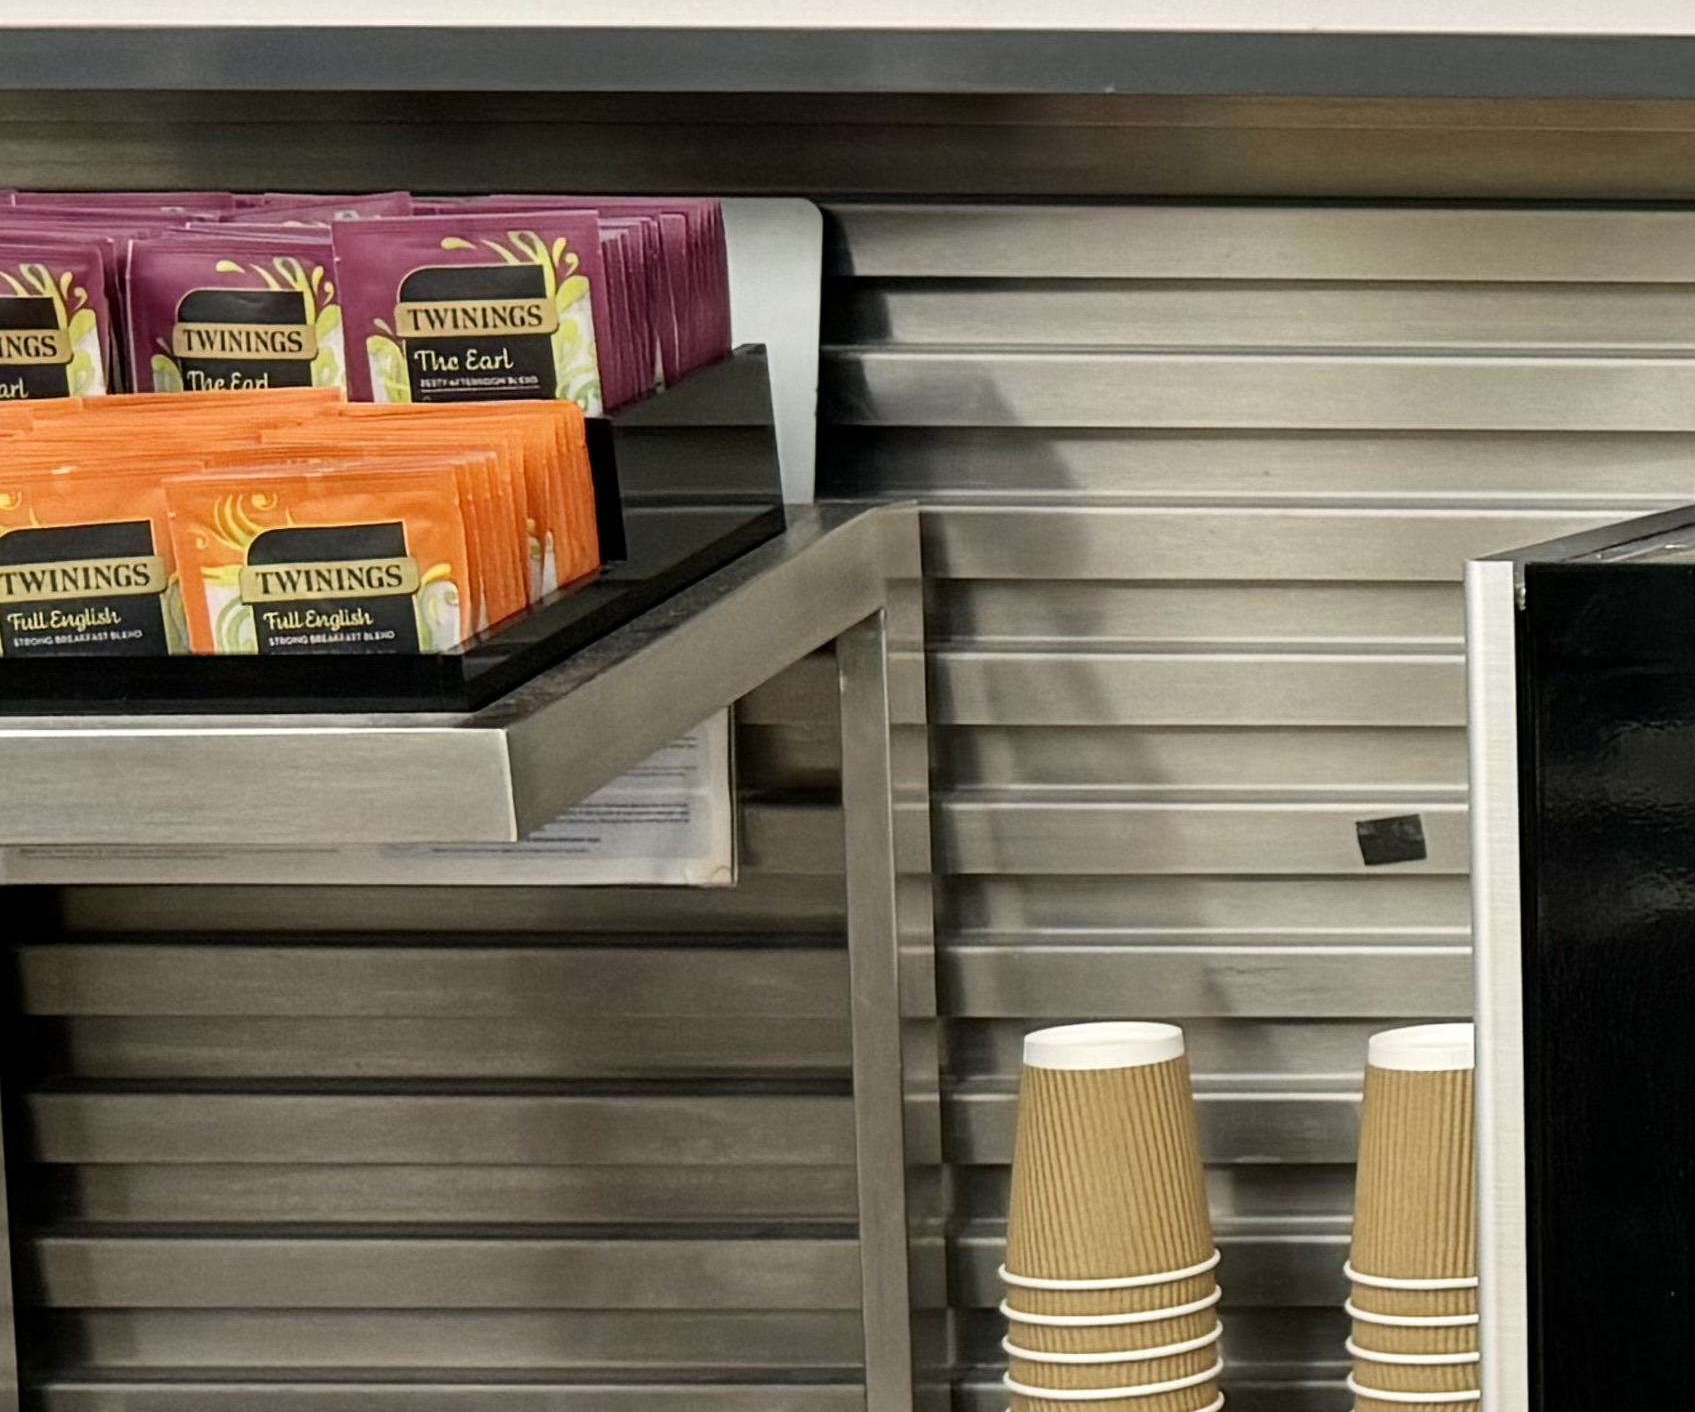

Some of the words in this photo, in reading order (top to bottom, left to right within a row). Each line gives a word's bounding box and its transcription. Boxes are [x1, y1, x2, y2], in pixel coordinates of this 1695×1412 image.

[407, 305, 543, 330] TWININGS
[183, 329, 304, 353] TWININGS
[414, 350, 459, 371] The
[466, 347, 514, 370] Earl
[0, 377, 29, 398] arl
[187, 371, 226, 391] The
[230, 372, 269, 390] Earl
[0, 563, 151, 596] TWININGS
[256, 564, 403, 595] TWININGS
[7, 610, 48, 631] Full
[50, 606, 121, 632] English
[263, 609, 304, 631] Full
[305, 607, 374, 631] English
[13, 635, 54, 647] STRONG
[55, 631, 108, 644] BREAKFAST
[110, 629, 143, 640] BLEND
[269, 635, 308, 647] STRONG
[310, 632, 361, 644] BREAKFAST
[363, 630, 395, 641] BLEND
